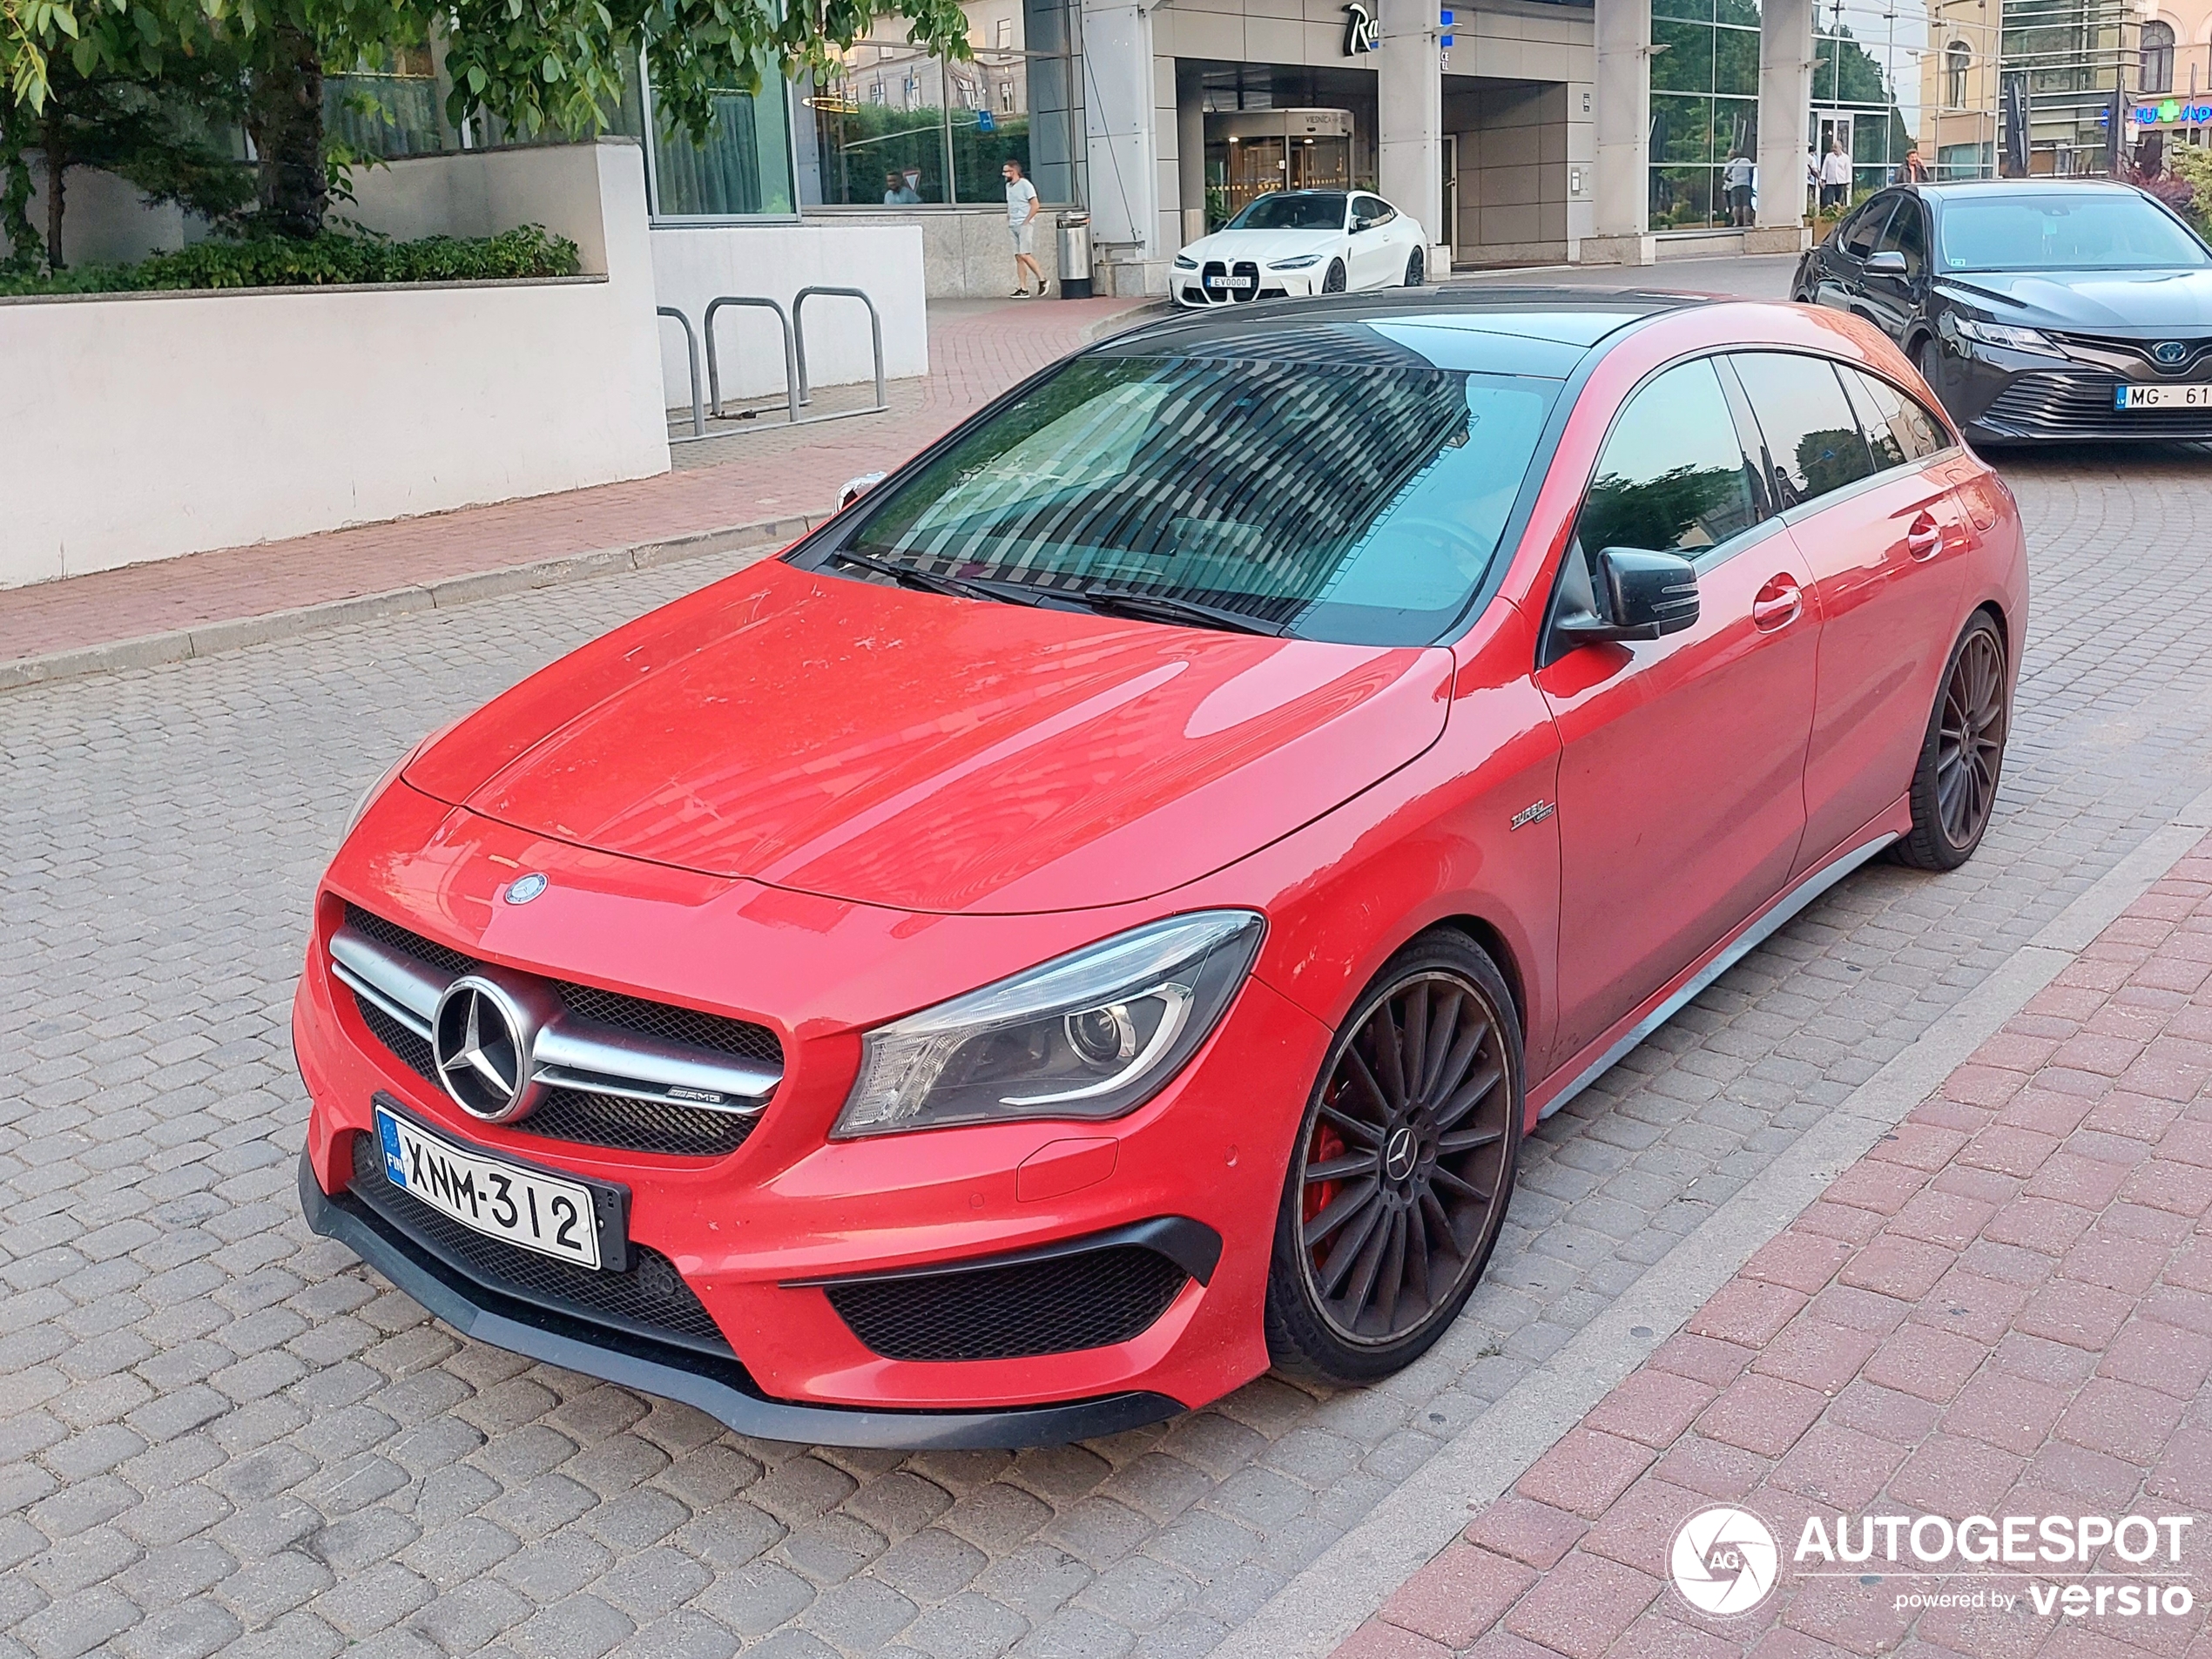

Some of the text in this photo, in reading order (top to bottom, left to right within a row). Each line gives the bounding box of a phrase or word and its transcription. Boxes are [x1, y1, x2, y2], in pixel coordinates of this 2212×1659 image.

[1214, 278, 1247, 287] EV0000
[1511, 799, 1544, 826] TURBO
[685, 1091, 720, 1103] AMG
[387, 1135, 583, 1251] FIN XNM-312
